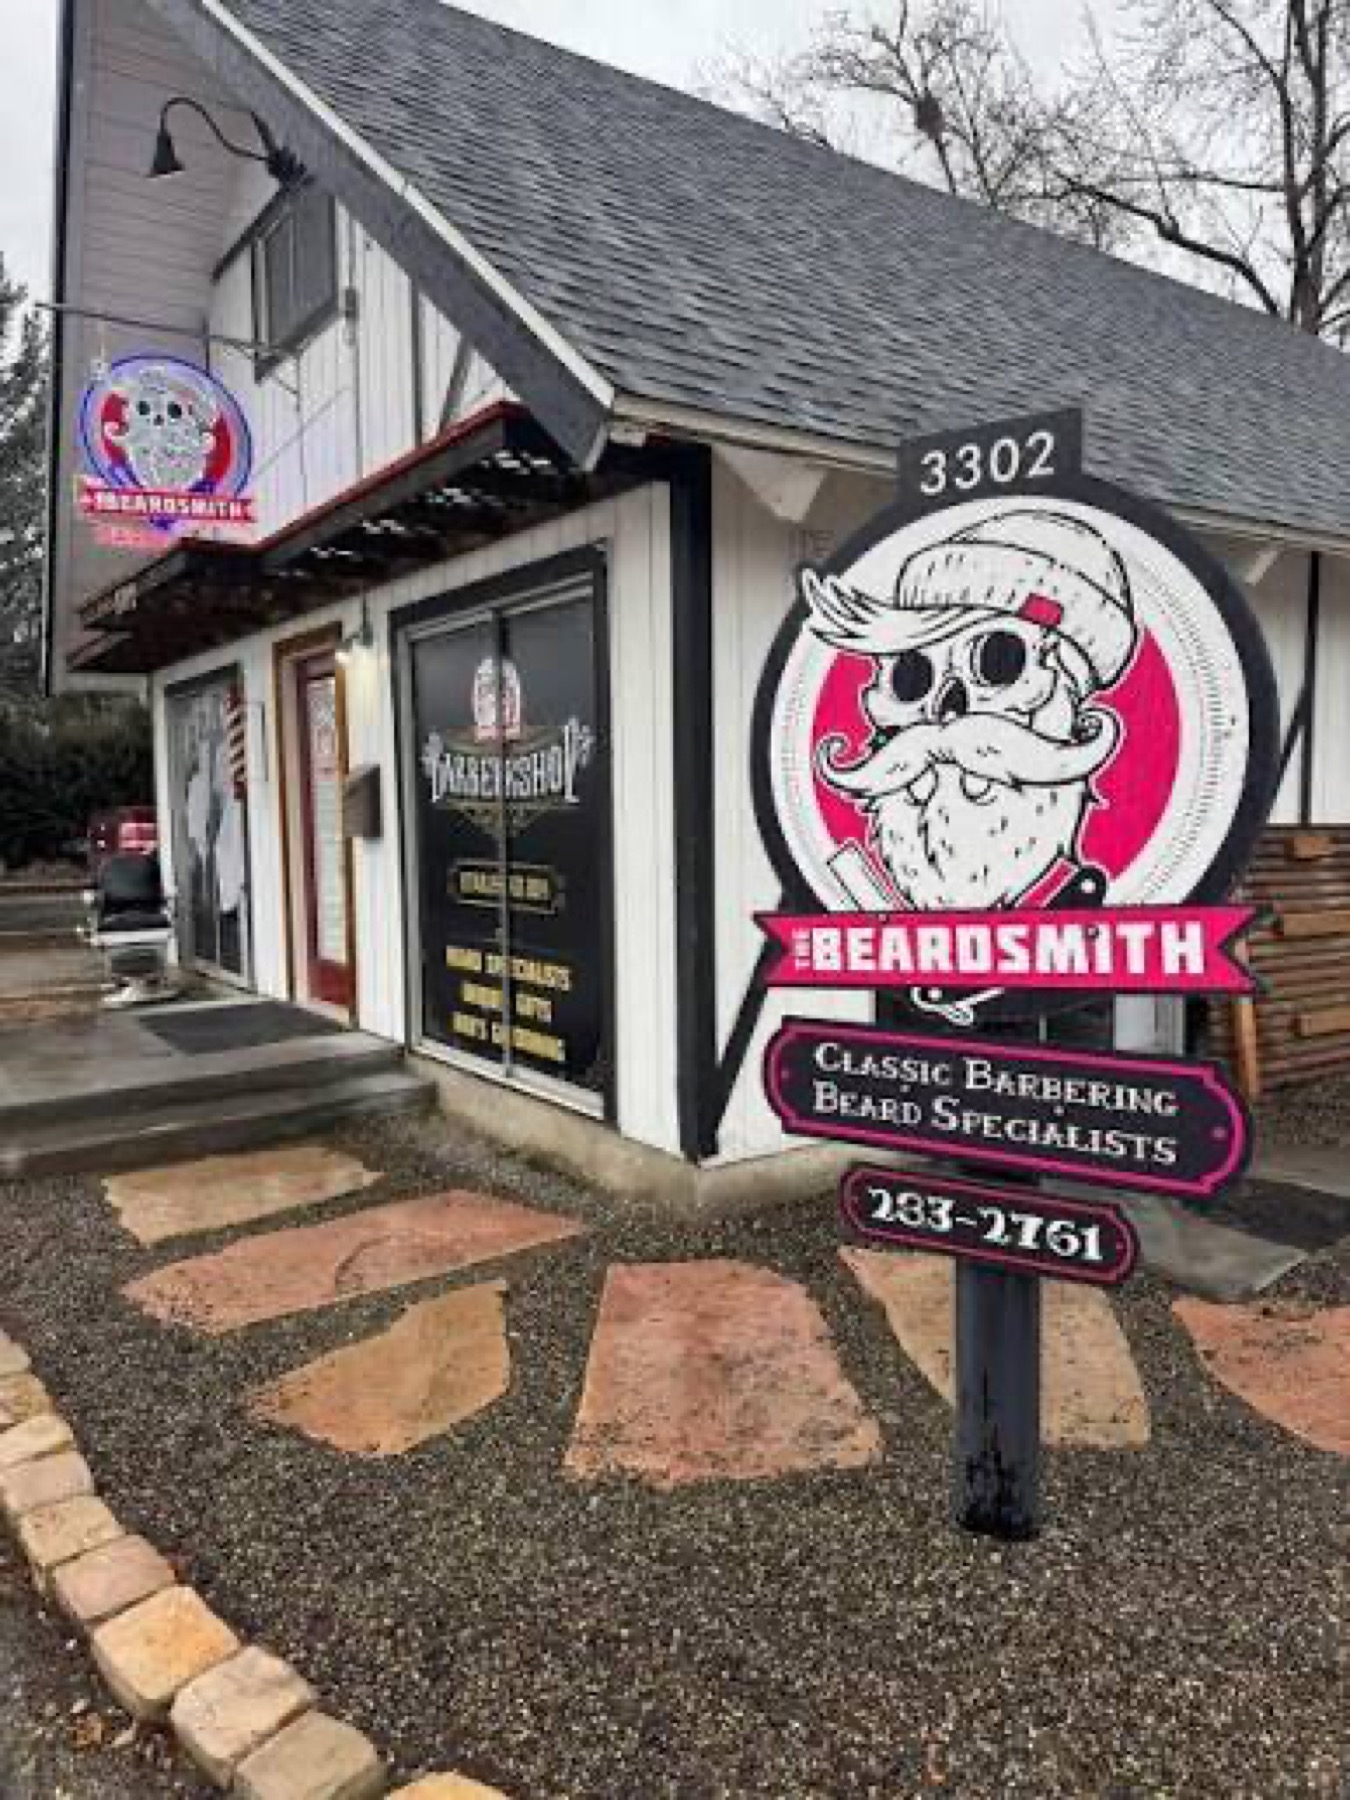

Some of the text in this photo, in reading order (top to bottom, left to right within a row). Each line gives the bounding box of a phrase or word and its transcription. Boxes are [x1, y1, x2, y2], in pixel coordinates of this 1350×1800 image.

[920, 429, 1055, 494] 3302
[812, 920, 1206, 974] BEARDSMITH
[814, 1042, 1178, 1117] CLASSIC BARBERING
[813, 1080, 1178, 1165] BEARD SPECIALISTS
[867, 1187, 1104, 1262] 283-2761
